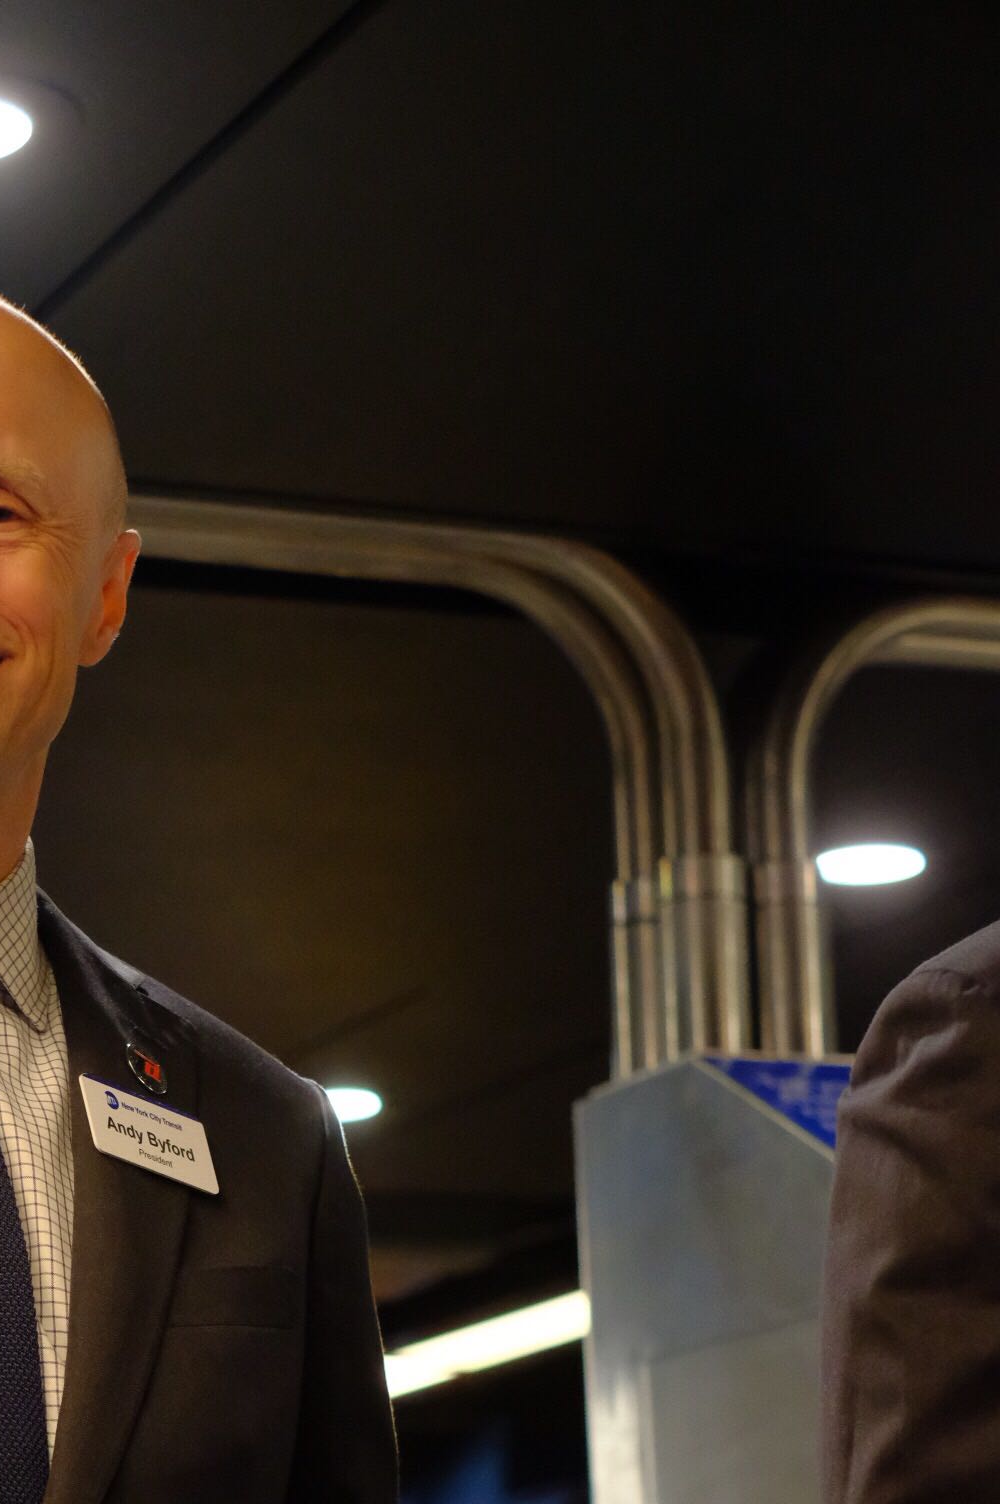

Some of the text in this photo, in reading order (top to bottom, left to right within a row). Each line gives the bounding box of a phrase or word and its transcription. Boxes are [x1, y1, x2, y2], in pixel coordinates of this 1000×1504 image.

[121, 1102, 183, 1131] New York City Transit
[107, 1116, 196, 1162] Andy Byford
[138, 1149, 173, 1168] President
